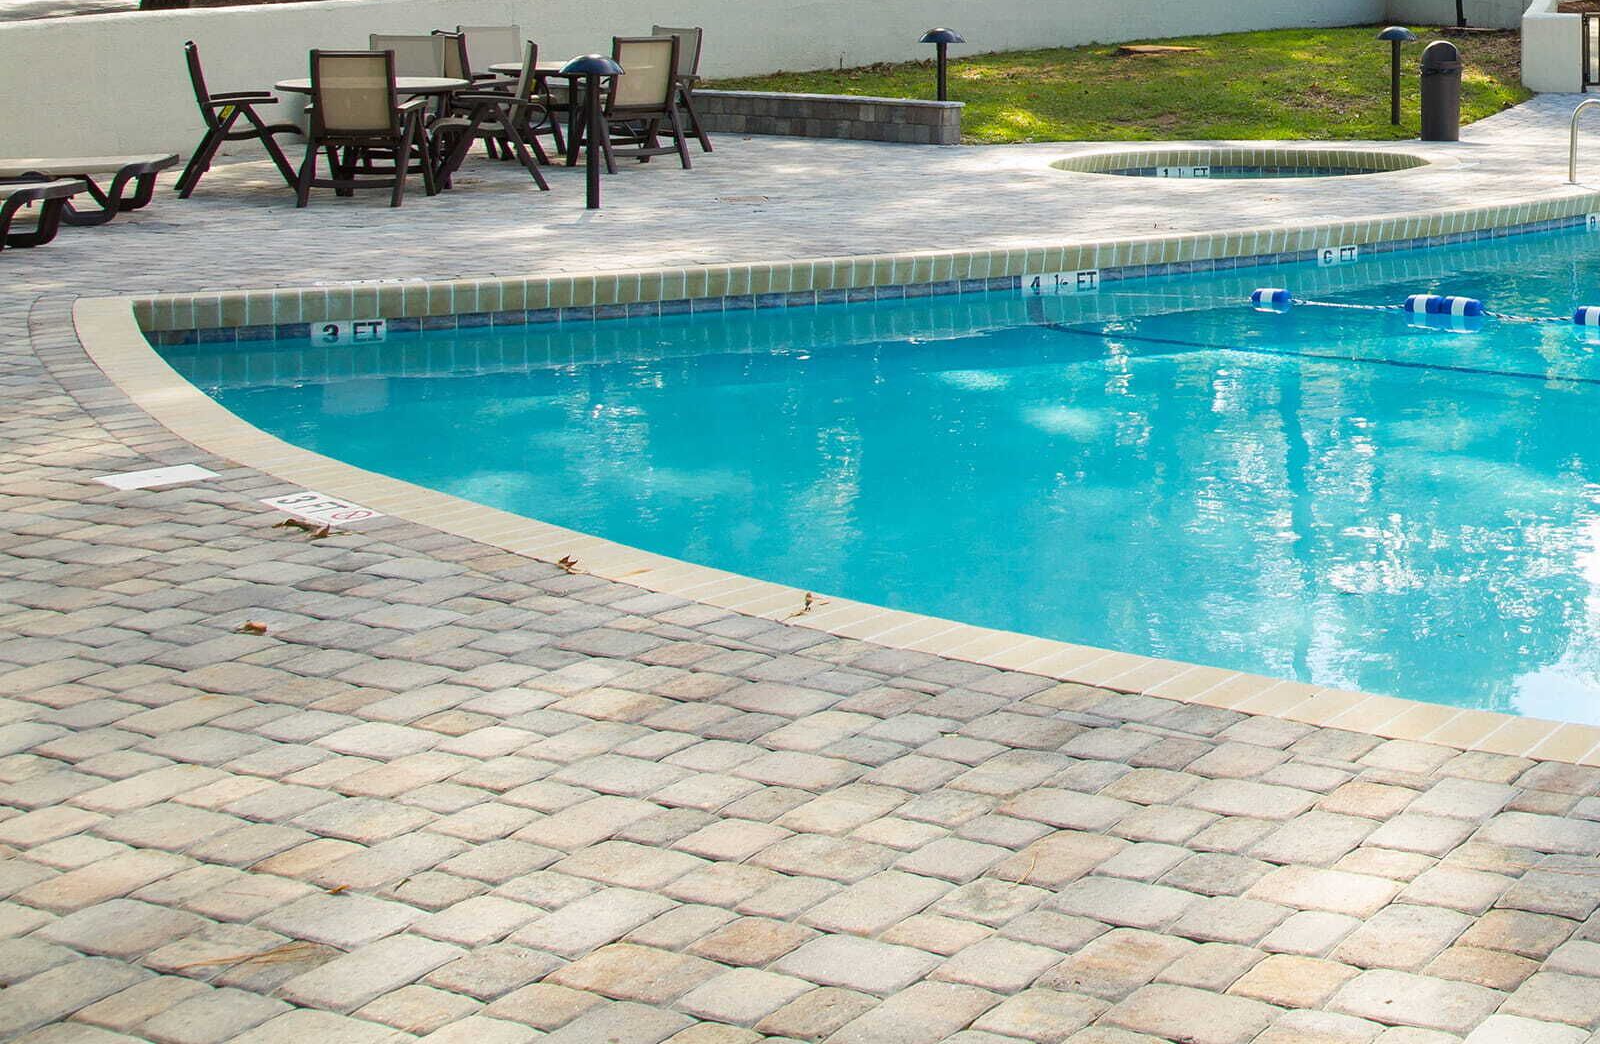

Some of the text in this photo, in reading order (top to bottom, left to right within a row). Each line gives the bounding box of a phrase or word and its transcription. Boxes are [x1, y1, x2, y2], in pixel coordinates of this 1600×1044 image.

[1076, 271, 1097, 291] FT
[322, 321, 384, 343] 3 FT
